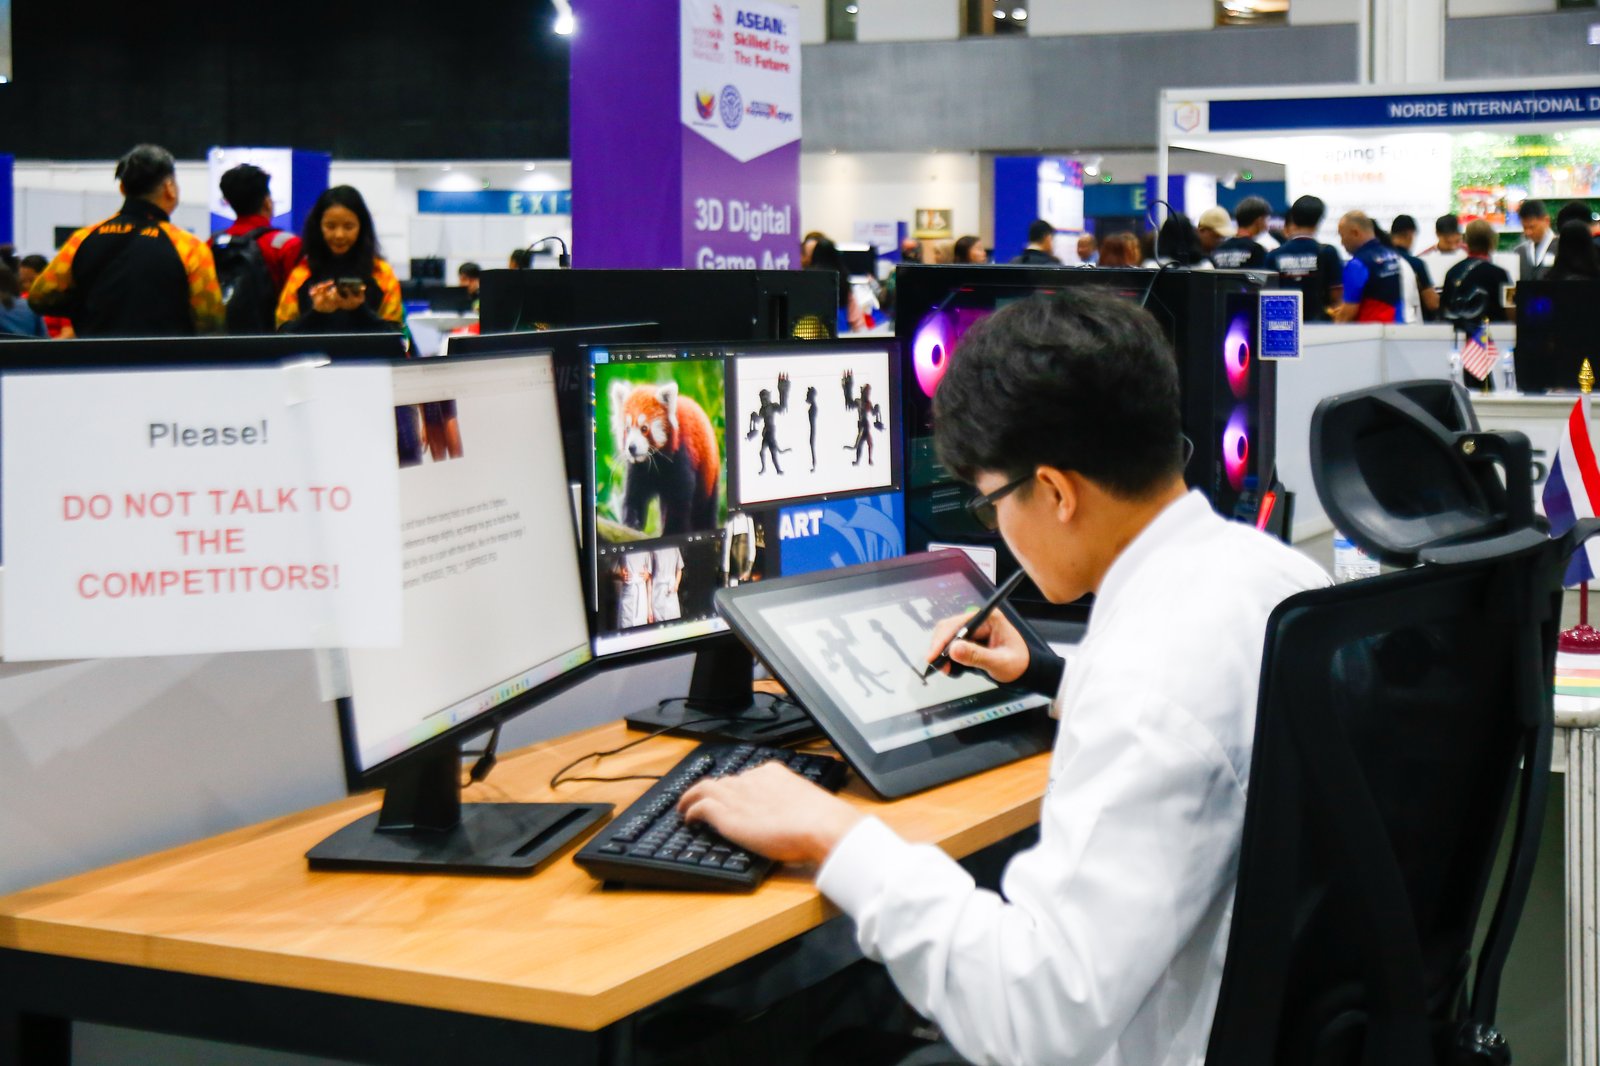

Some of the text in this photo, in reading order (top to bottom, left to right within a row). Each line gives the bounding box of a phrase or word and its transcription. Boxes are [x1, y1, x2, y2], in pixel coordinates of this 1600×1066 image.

[736, 11, 787, 35] ASEAN:
[734, 32, 770, 51] Skilled
[734, 50, 790, 73] The Future
[1390, 102, 1448, 118] NORDE
[1452, 97, 1586, 116] INTERNATIONAL
[695, 197, 791, 241] 3D Digital
[697, 247, 790, 270] Game Art
[148, 419, 269, 448] Please!
[62, 485, 352, 521] DO NOT TALK TO
[778, 510, 824, 540] ART
[175, 528, 246, 556] THE
[77, 564, 340, 599] COMPETITORS!
